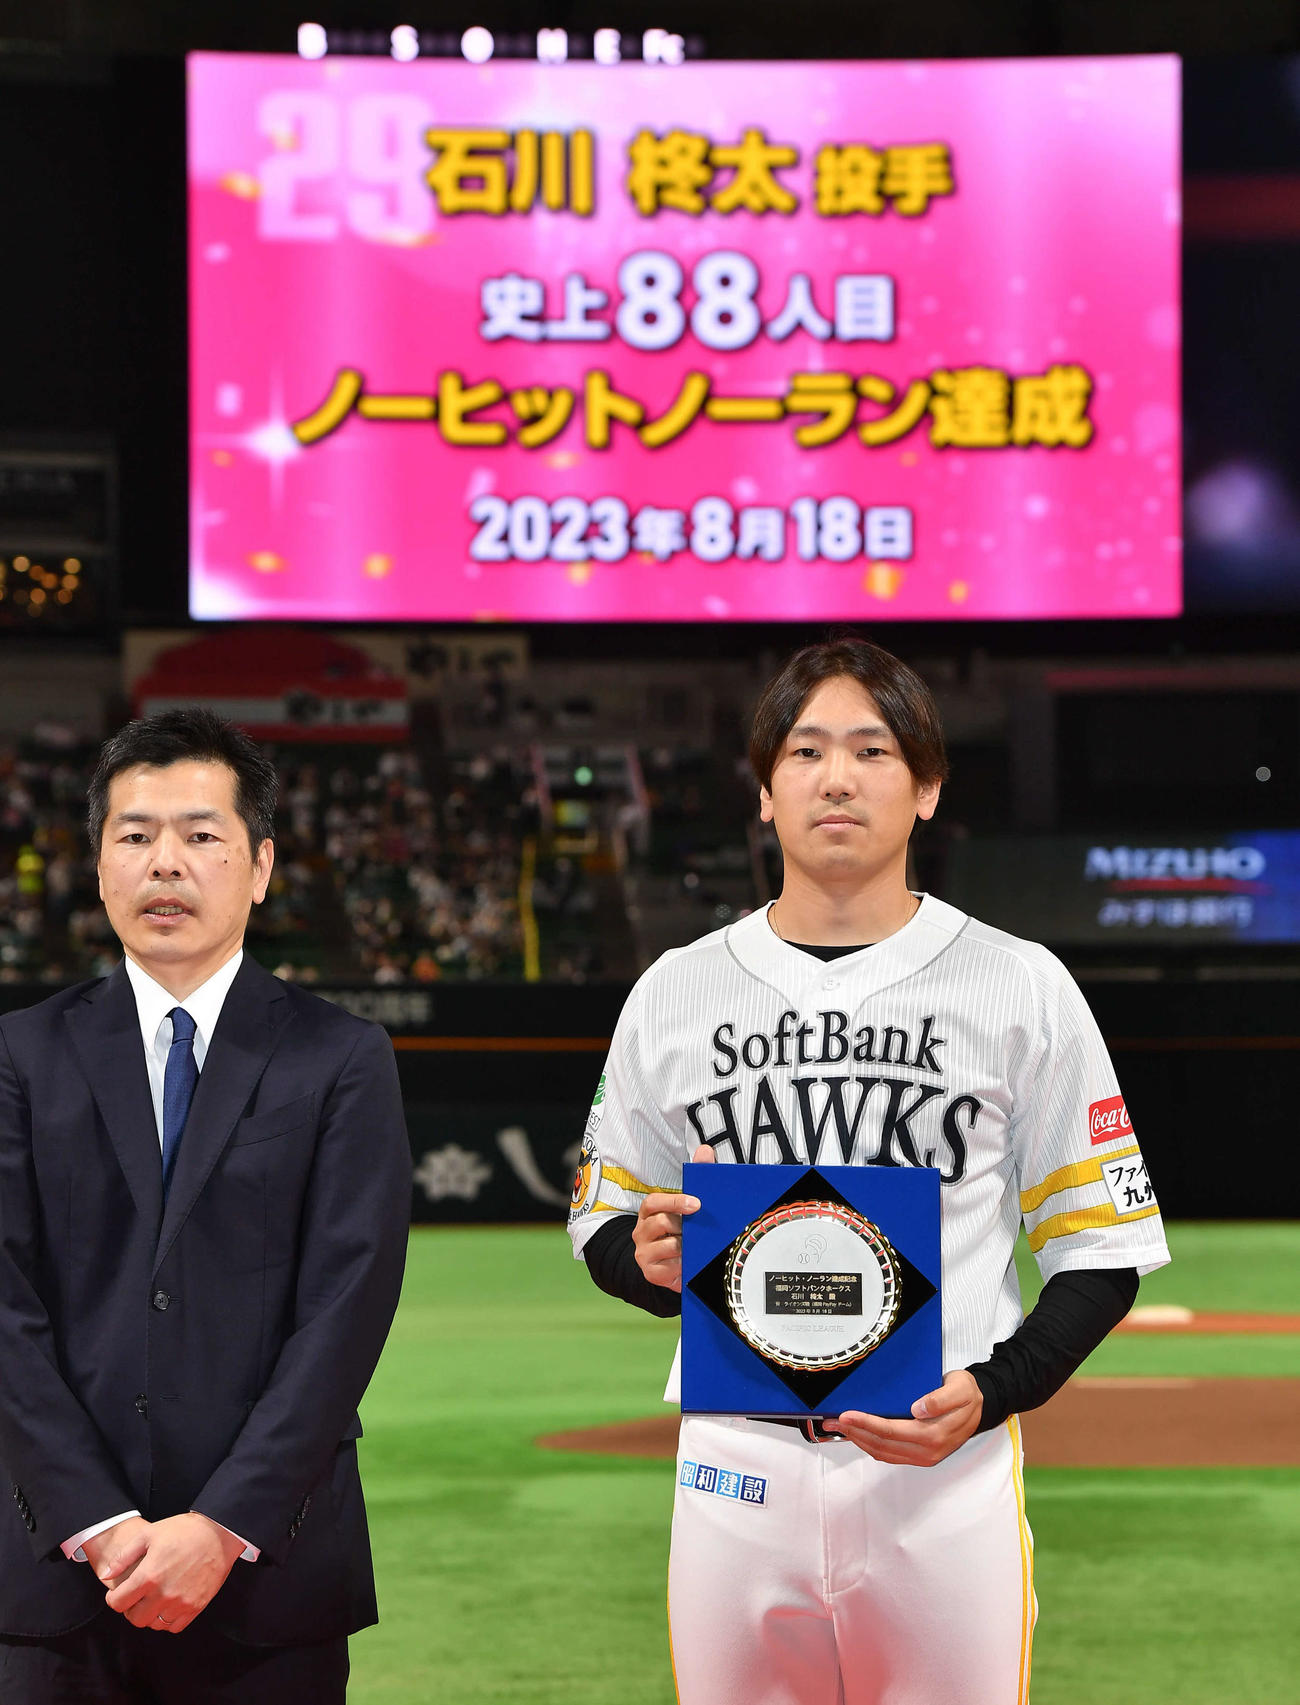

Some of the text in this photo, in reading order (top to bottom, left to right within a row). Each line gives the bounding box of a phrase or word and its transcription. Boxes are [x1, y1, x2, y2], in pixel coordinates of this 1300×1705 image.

[258, 89, 434, 241] 29
[424, 128, 955, 216] 石川 柊太 投手
[480, 251, 895, 349] 史上88人目
[292, 364, 1093, 450] ノーヒットノーラン達成
[468, 496, 912, 563] 2023年8月18日
[712, 1009, 946, 1078] SoftBank
[685, 1074, 983, 1187] HAWKS
[681, 1463, 763, 1502] 昭和建設
